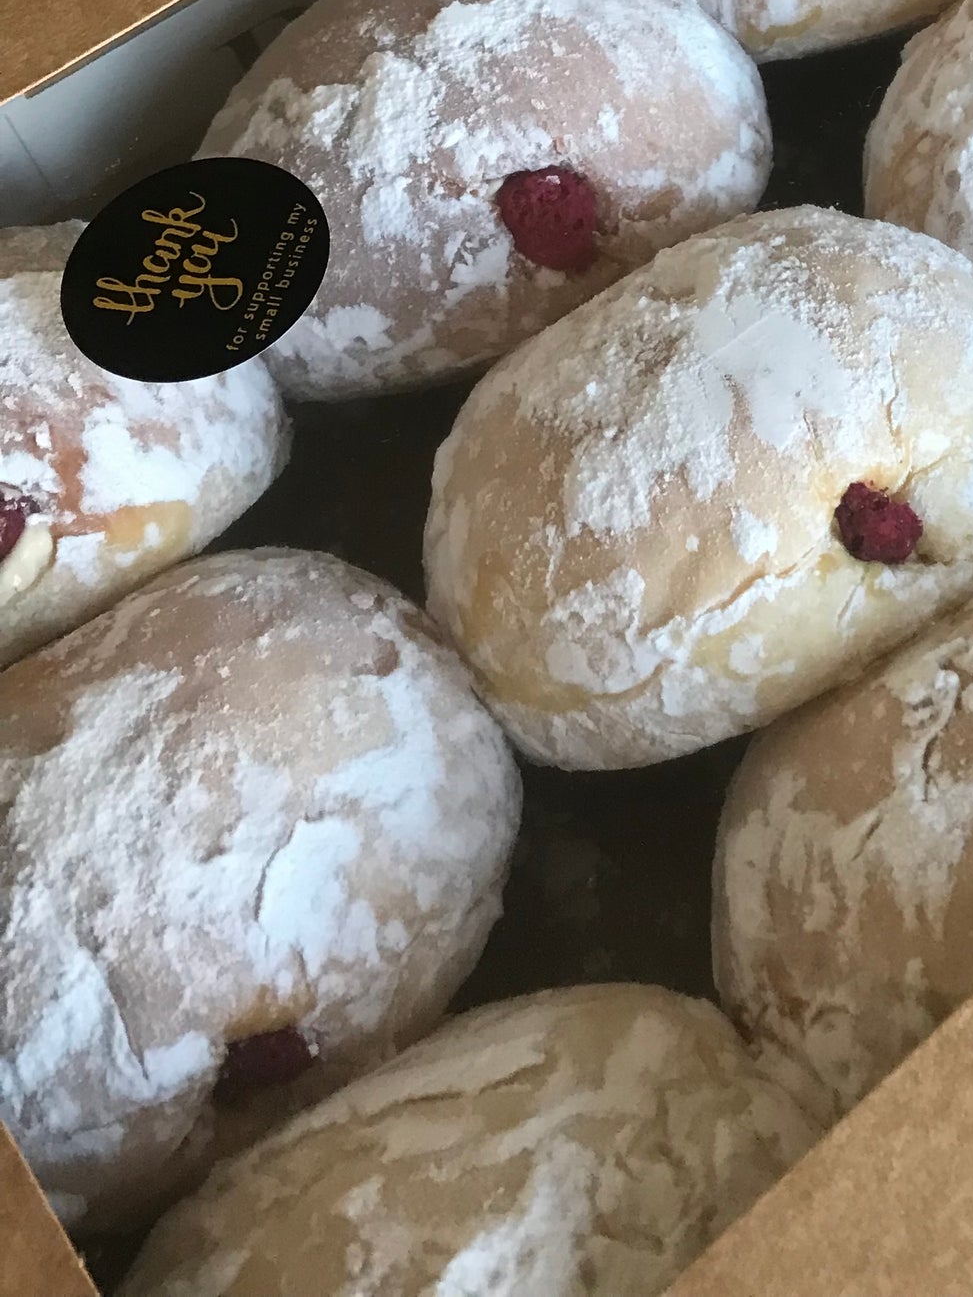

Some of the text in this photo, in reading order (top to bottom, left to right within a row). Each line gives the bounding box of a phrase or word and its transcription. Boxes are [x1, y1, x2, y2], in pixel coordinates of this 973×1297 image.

[93, 191, 206, 326] thank
[171, 218, 243, 311] you
[226, 203, 307, 351] for supporting my
[255, 218, 318, 341] small business
